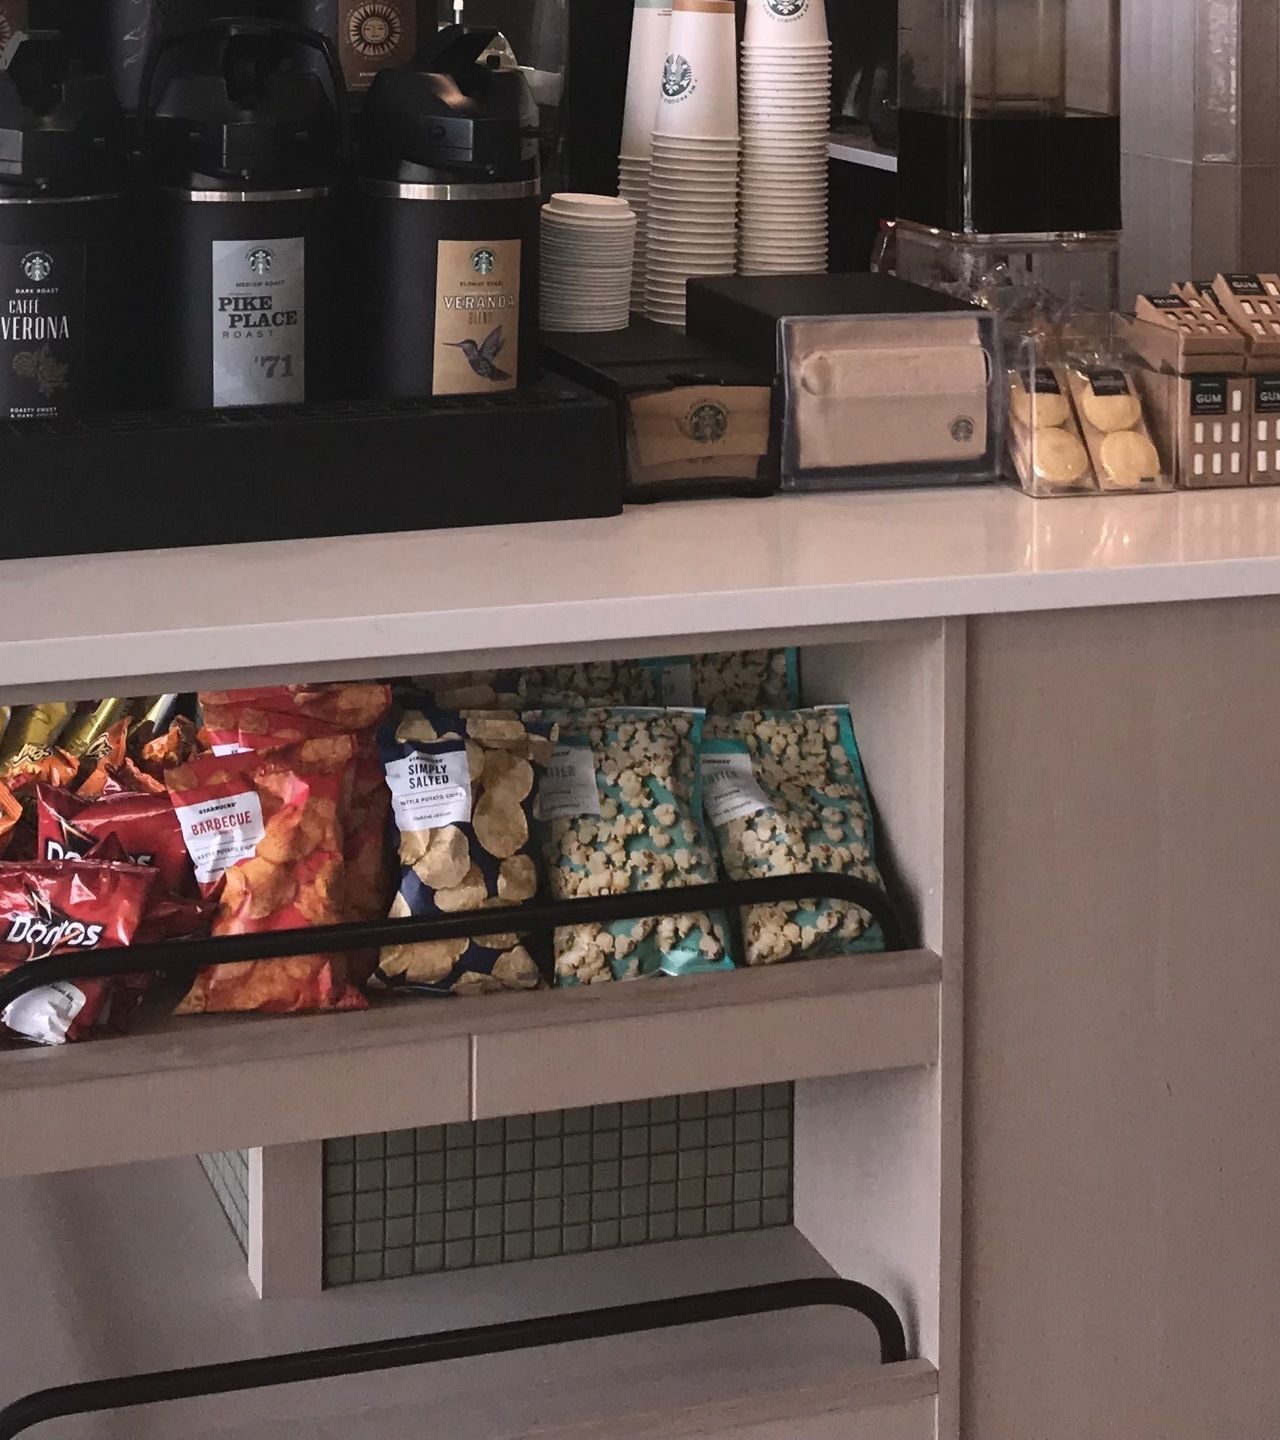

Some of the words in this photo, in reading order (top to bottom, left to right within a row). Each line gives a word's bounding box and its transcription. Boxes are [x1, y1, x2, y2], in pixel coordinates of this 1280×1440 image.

[15, 287, 35, 295] DARK
[1231, 280, 1261, 290] GUM
[218, 295, 273, 312] PIKE
[443, 294, 517, 311] VERANDA
[0, 315, 71, 341] VERONA
[228, 311, 298, 329] PLACE
[222, 330, 275, 340] ROAST
[1195, 392, 1223, 404] GUM
[407, 763, 448, 776] SIMPLY
[408, 774, 450, 790] SALTED
[190, 810, 253, 837] BARBECUE
